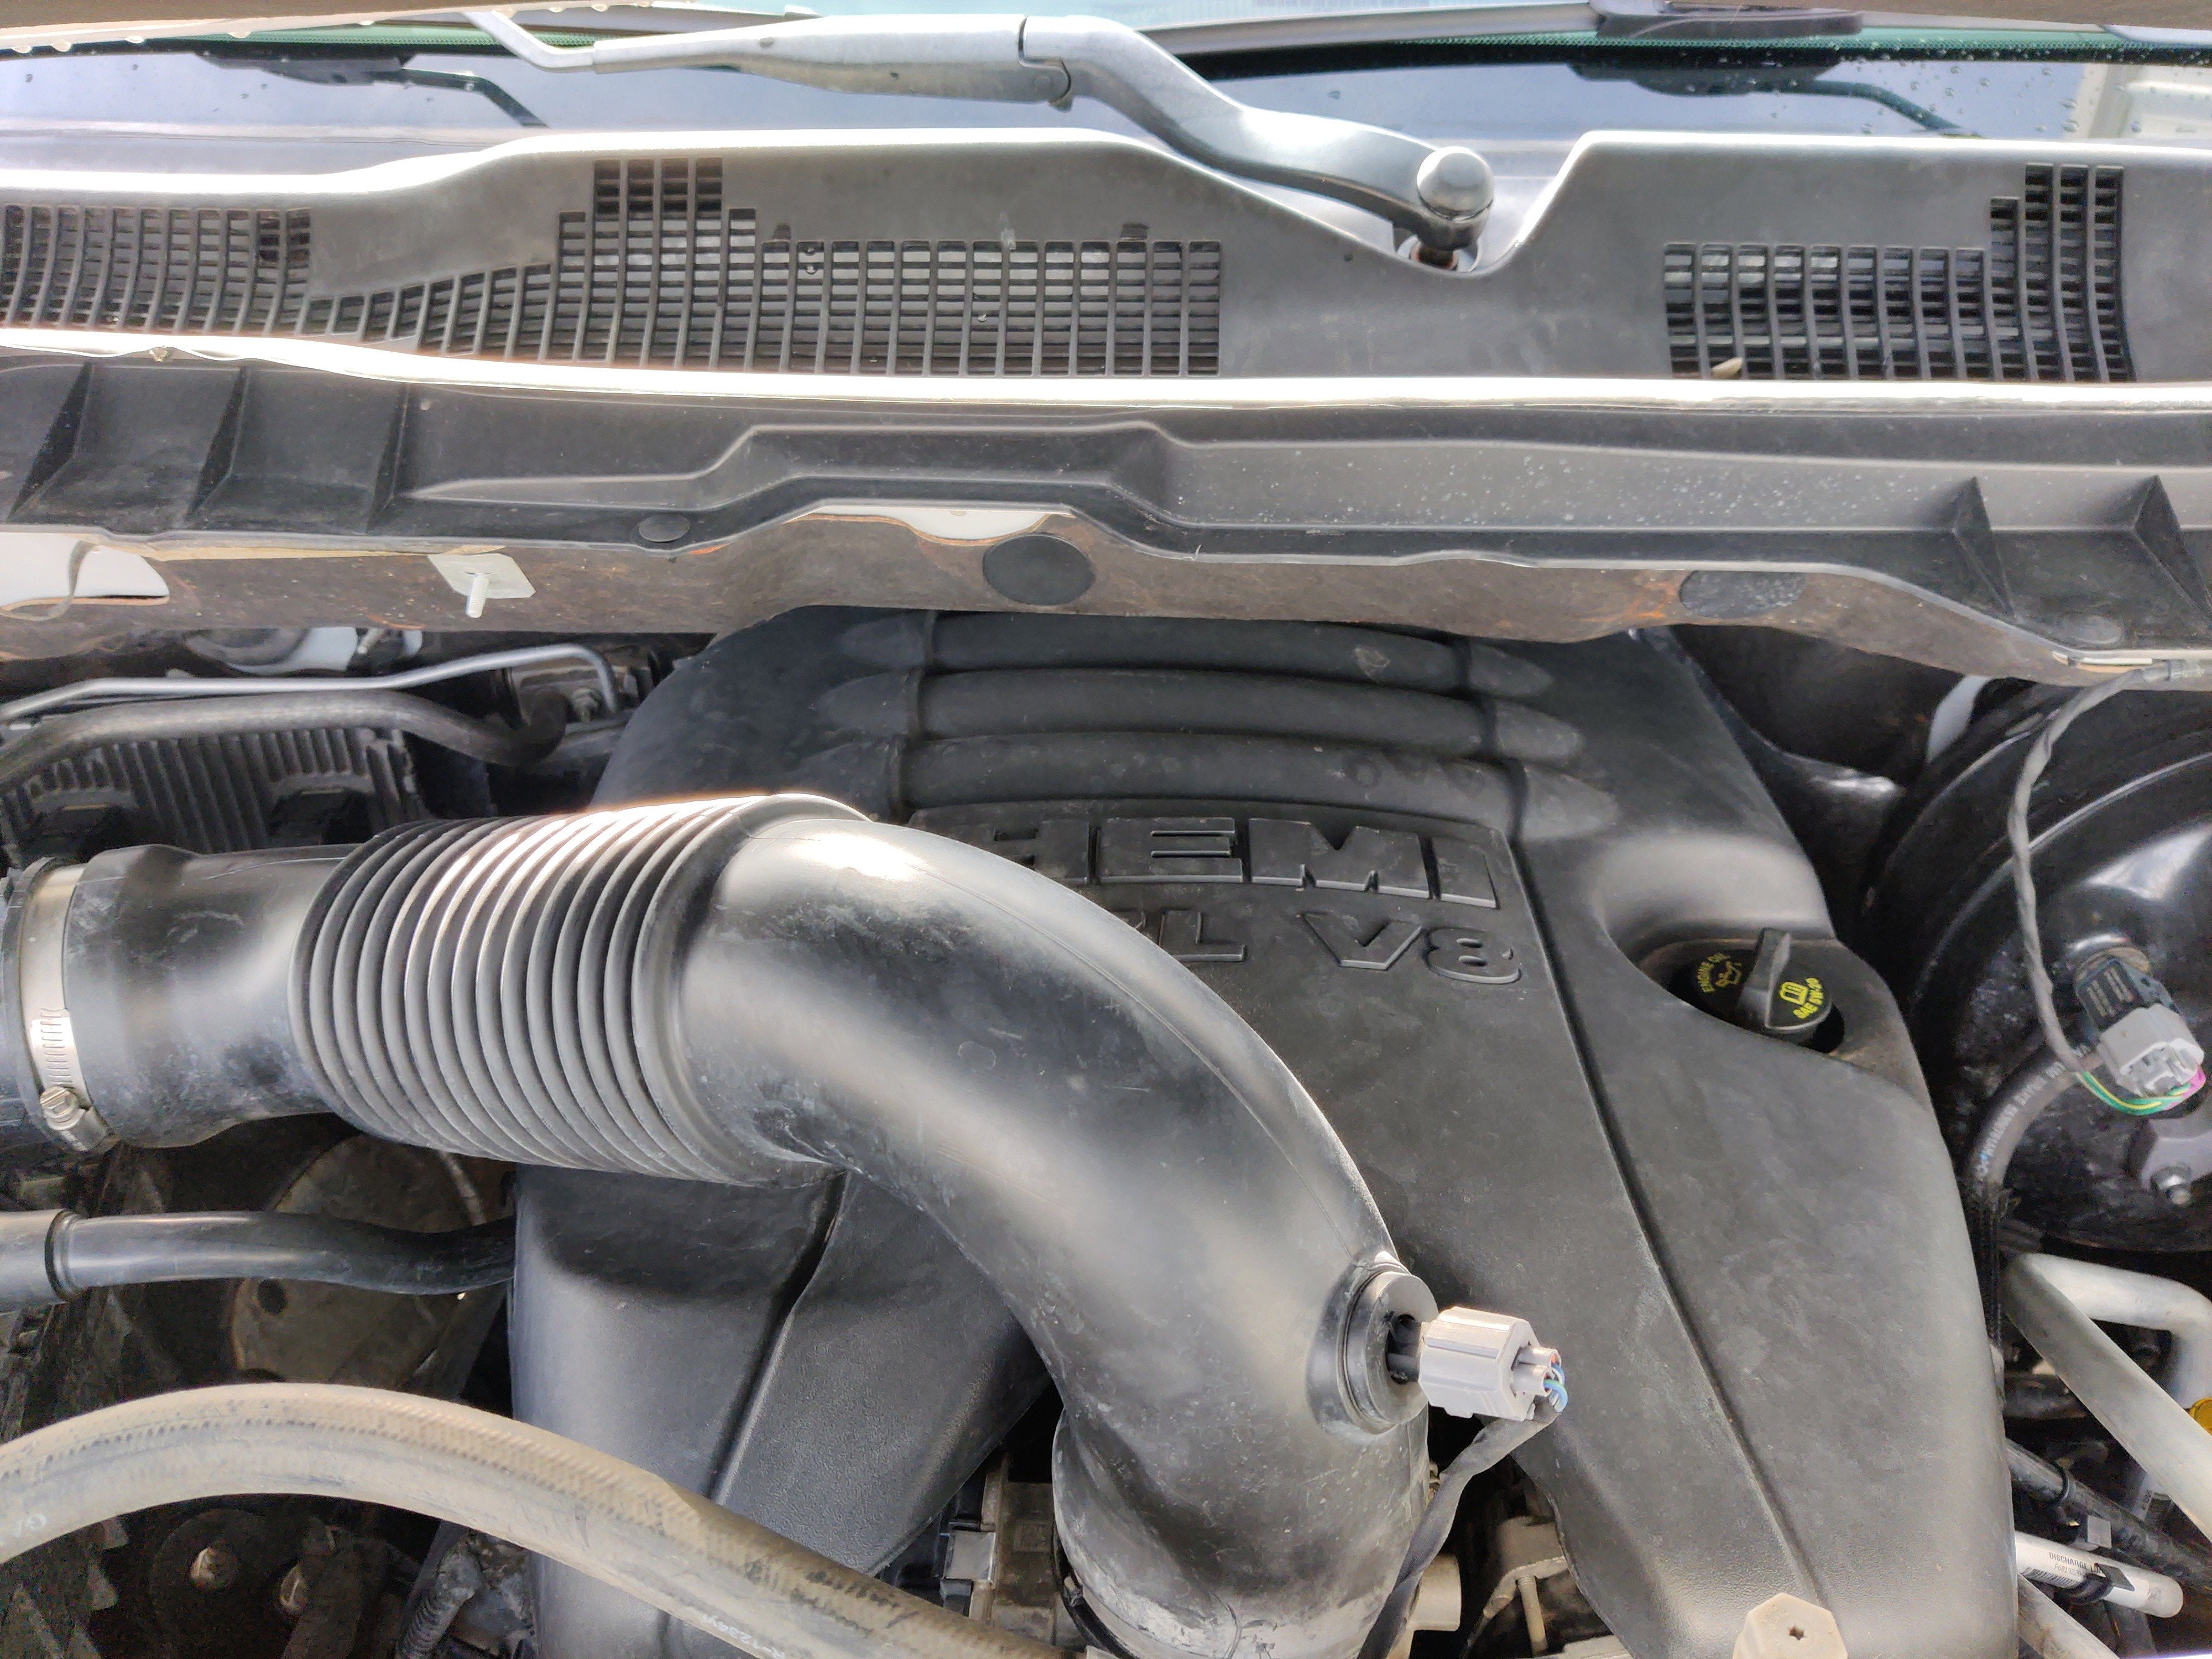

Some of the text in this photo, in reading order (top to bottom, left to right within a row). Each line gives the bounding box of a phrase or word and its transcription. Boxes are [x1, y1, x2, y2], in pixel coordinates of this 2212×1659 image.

[947, 817, 1500, 910] HEMI
[1296, 910, 1522, 985] V8
[1793, 1002, 1818, 1019] SAE
[2049, 1552, 2105, 1574] DISCHARGE LIN
